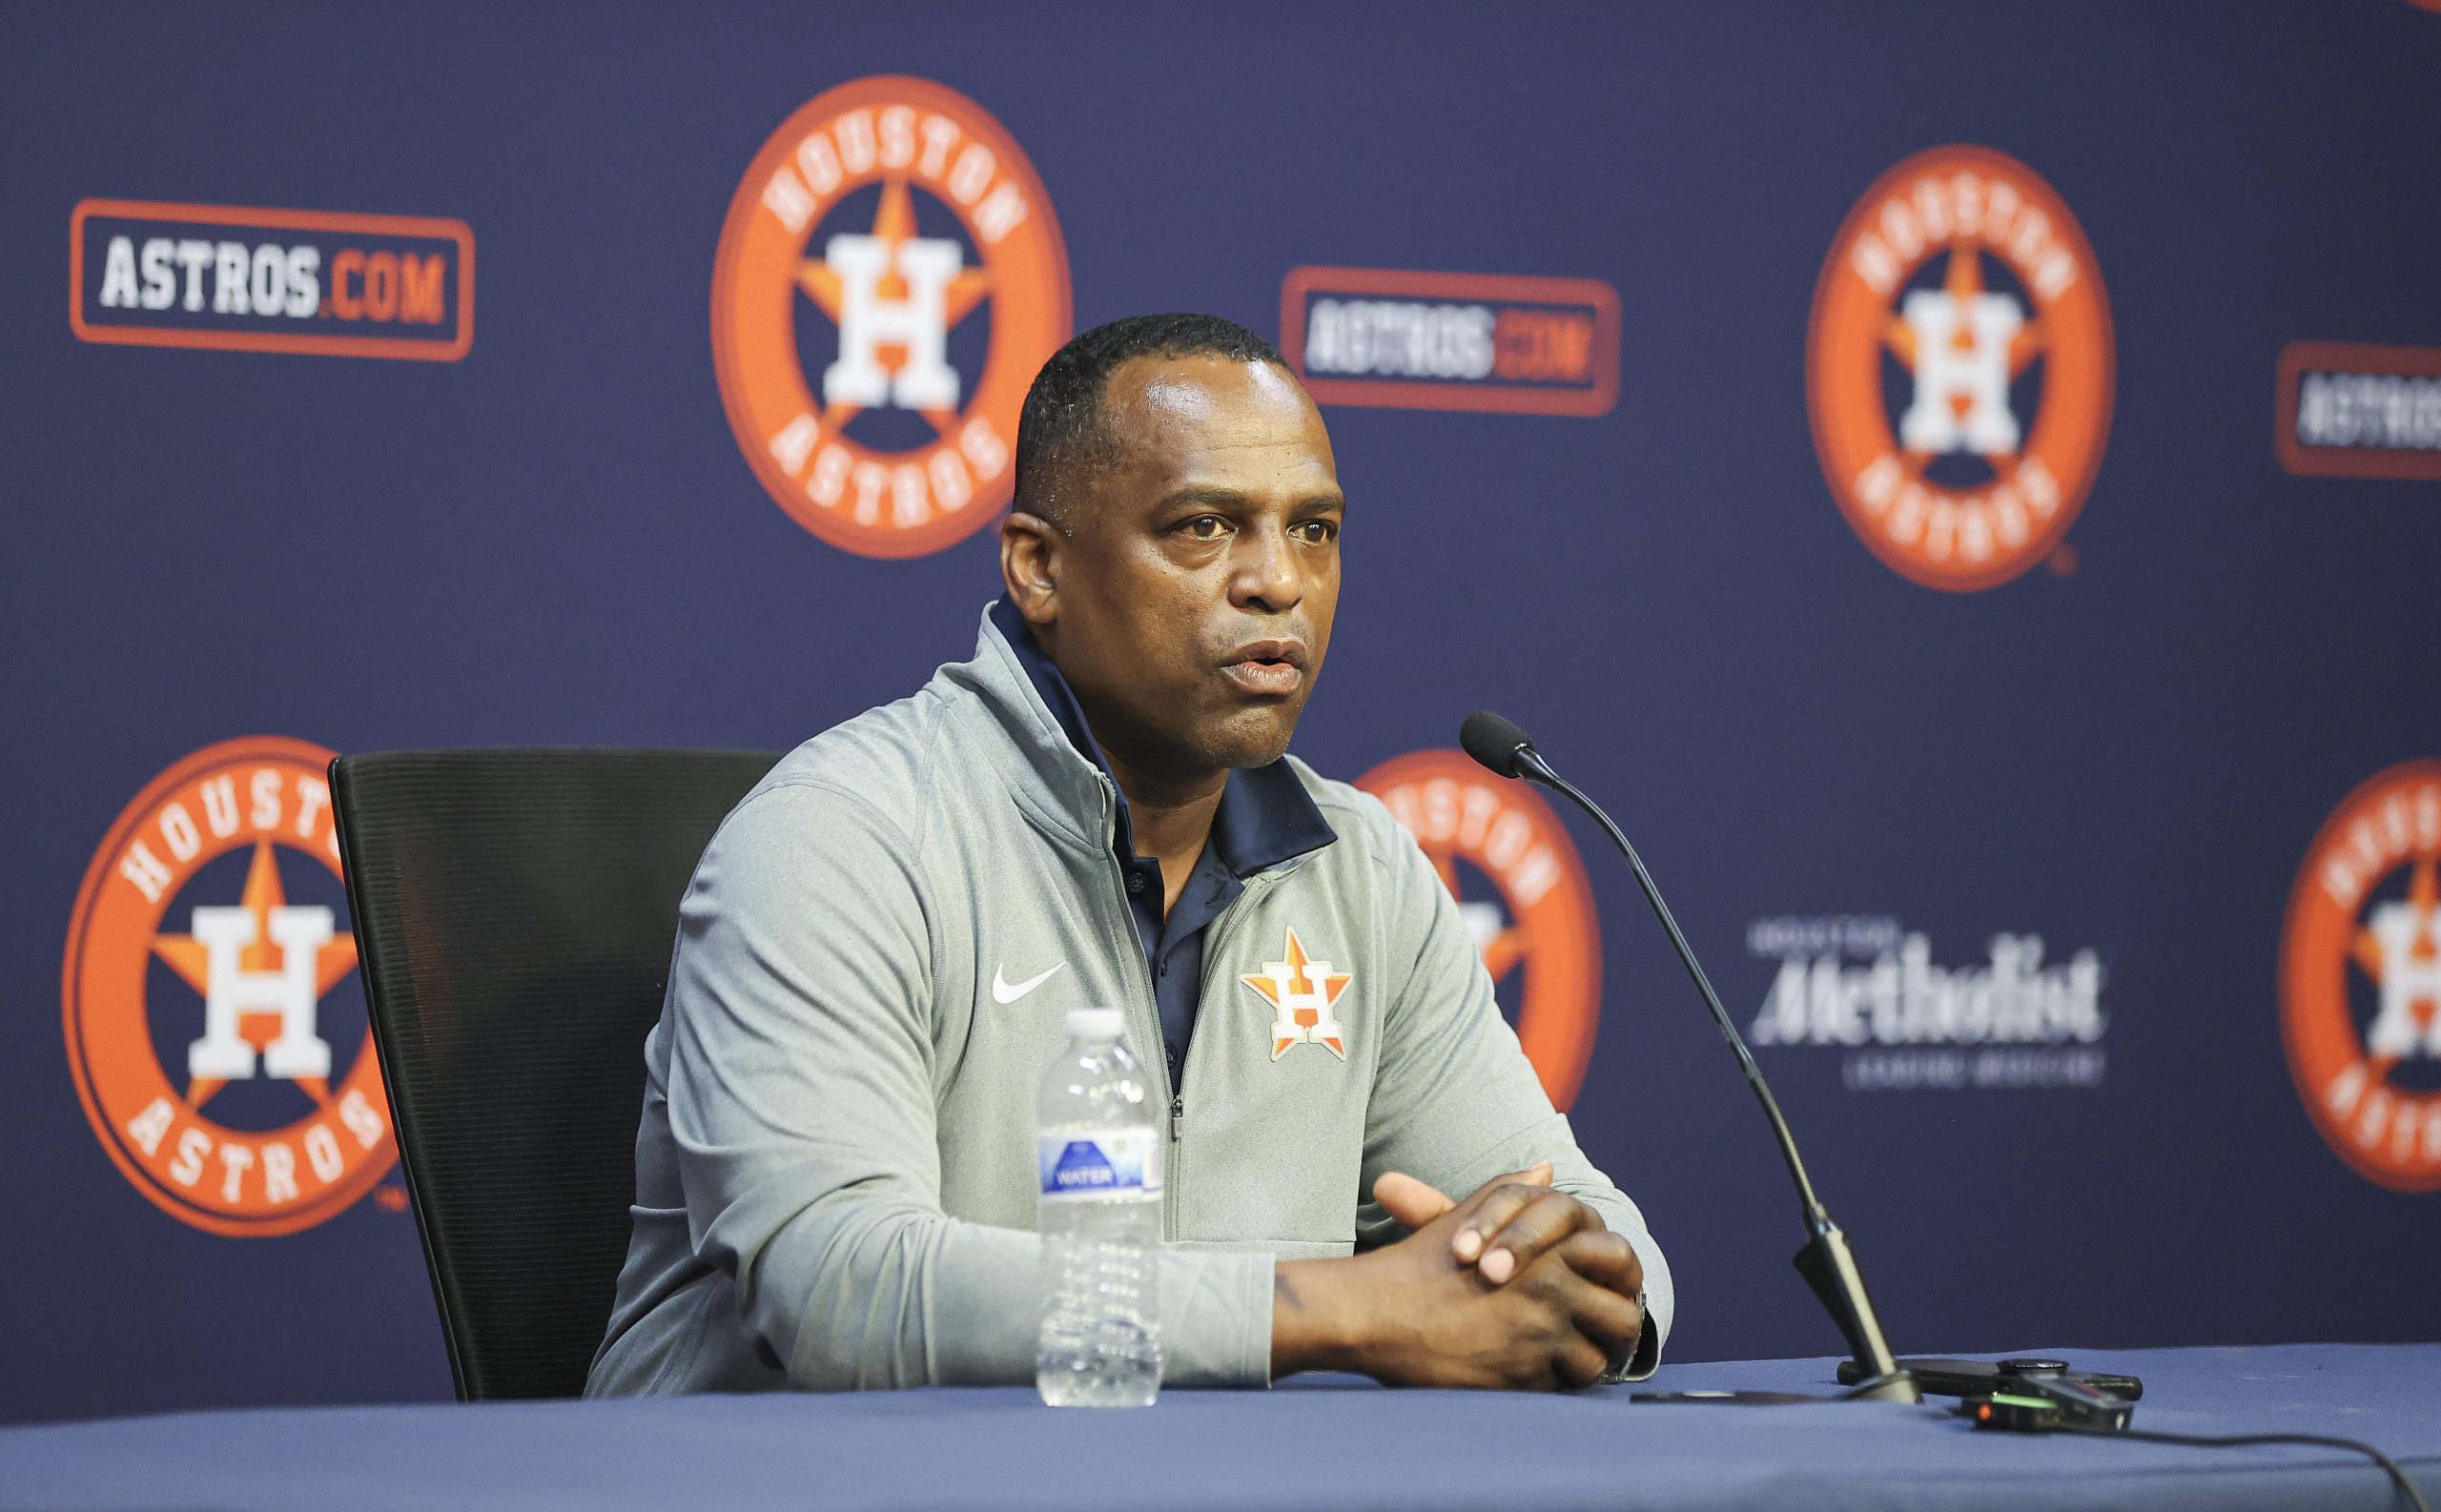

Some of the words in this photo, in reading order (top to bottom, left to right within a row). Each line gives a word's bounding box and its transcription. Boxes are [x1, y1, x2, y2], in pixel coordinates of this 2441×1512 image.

[761, 105, 1030, 245] HOUSTON
[99, 235, 447, 325] ASTROS.COM
[1851, 172, 2079, 303] HOUSTON
[823, 233, 963, 410] H
[1304, 297, 1592, 379] ASTROS.COM
[1899, 288, 2026, 456] H
[2297, 371, 2441, 450] ASTRO
[768, 413, 1009, 529] ASTROS
[1854, 455, 2060, 563] ASTROS
[119, 768, 343, 905] HOUST
[1381, 777, 1562, 908] USTON
[2321, 784, 2441, 909] HOUS
[188, 906, 335, 1079] H
[1262, 962, 1343, 1042] H
[127, 1088, 383, 1204] ASTROS
[1056, 1167, 1115, 1185] WATER
